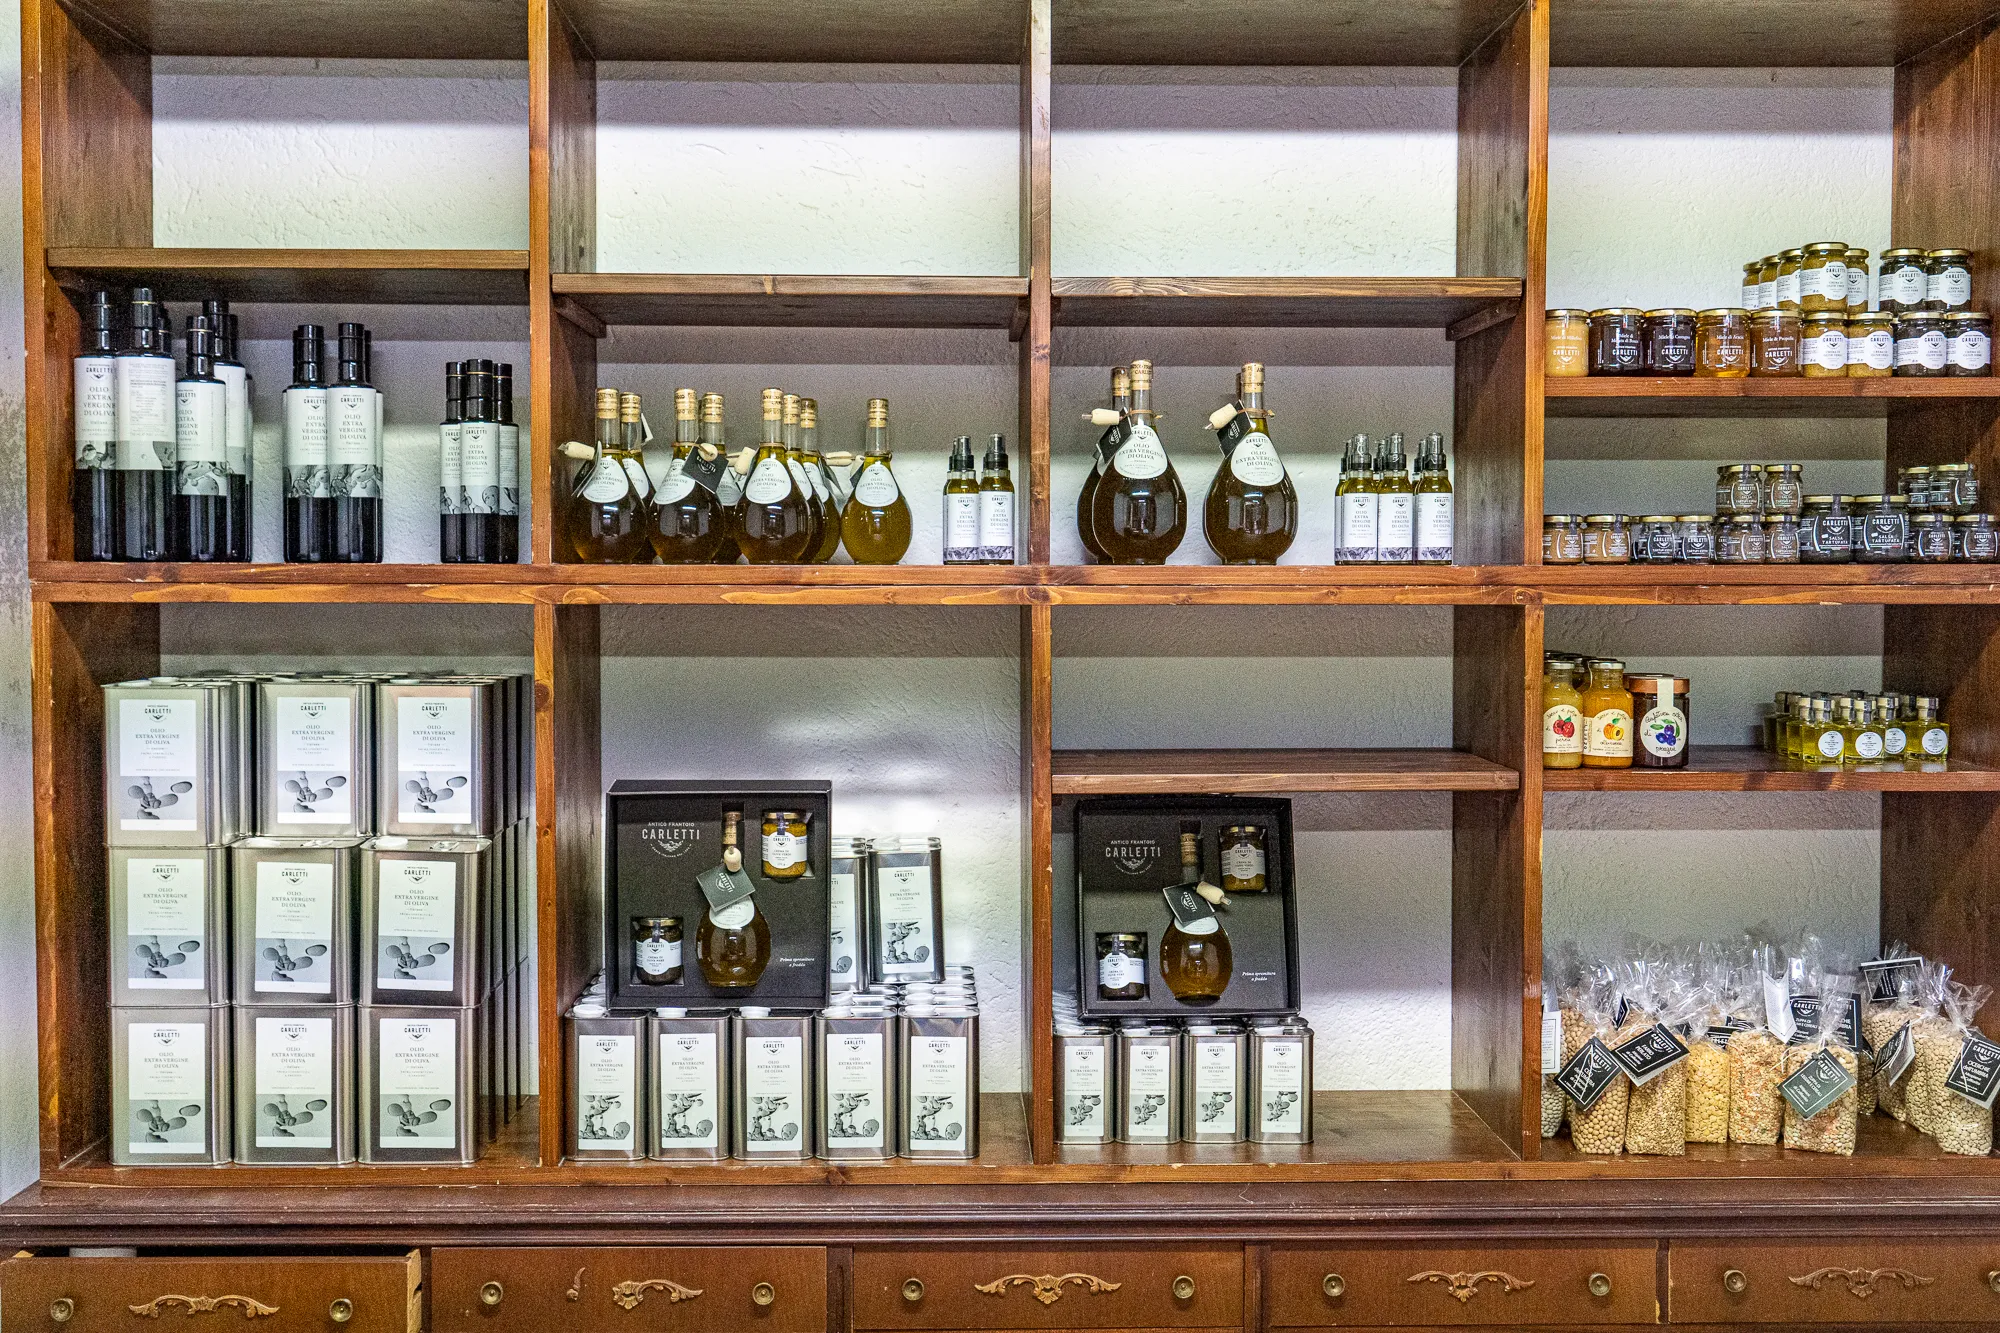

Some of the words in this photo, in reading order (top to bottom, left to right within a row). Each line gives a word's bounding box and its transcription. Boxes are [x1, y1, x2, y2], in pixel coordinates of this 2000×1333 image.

[642, 829, 700, 840] CARLETTI
[1105, 847, 1160, 857] CARLETTI
[719, 873, 734, 893] CARLETTI
[1651, 1034, 1672, 1053] CARLETTI
[1818, 1061, 1840, 1083] CARLETTI
